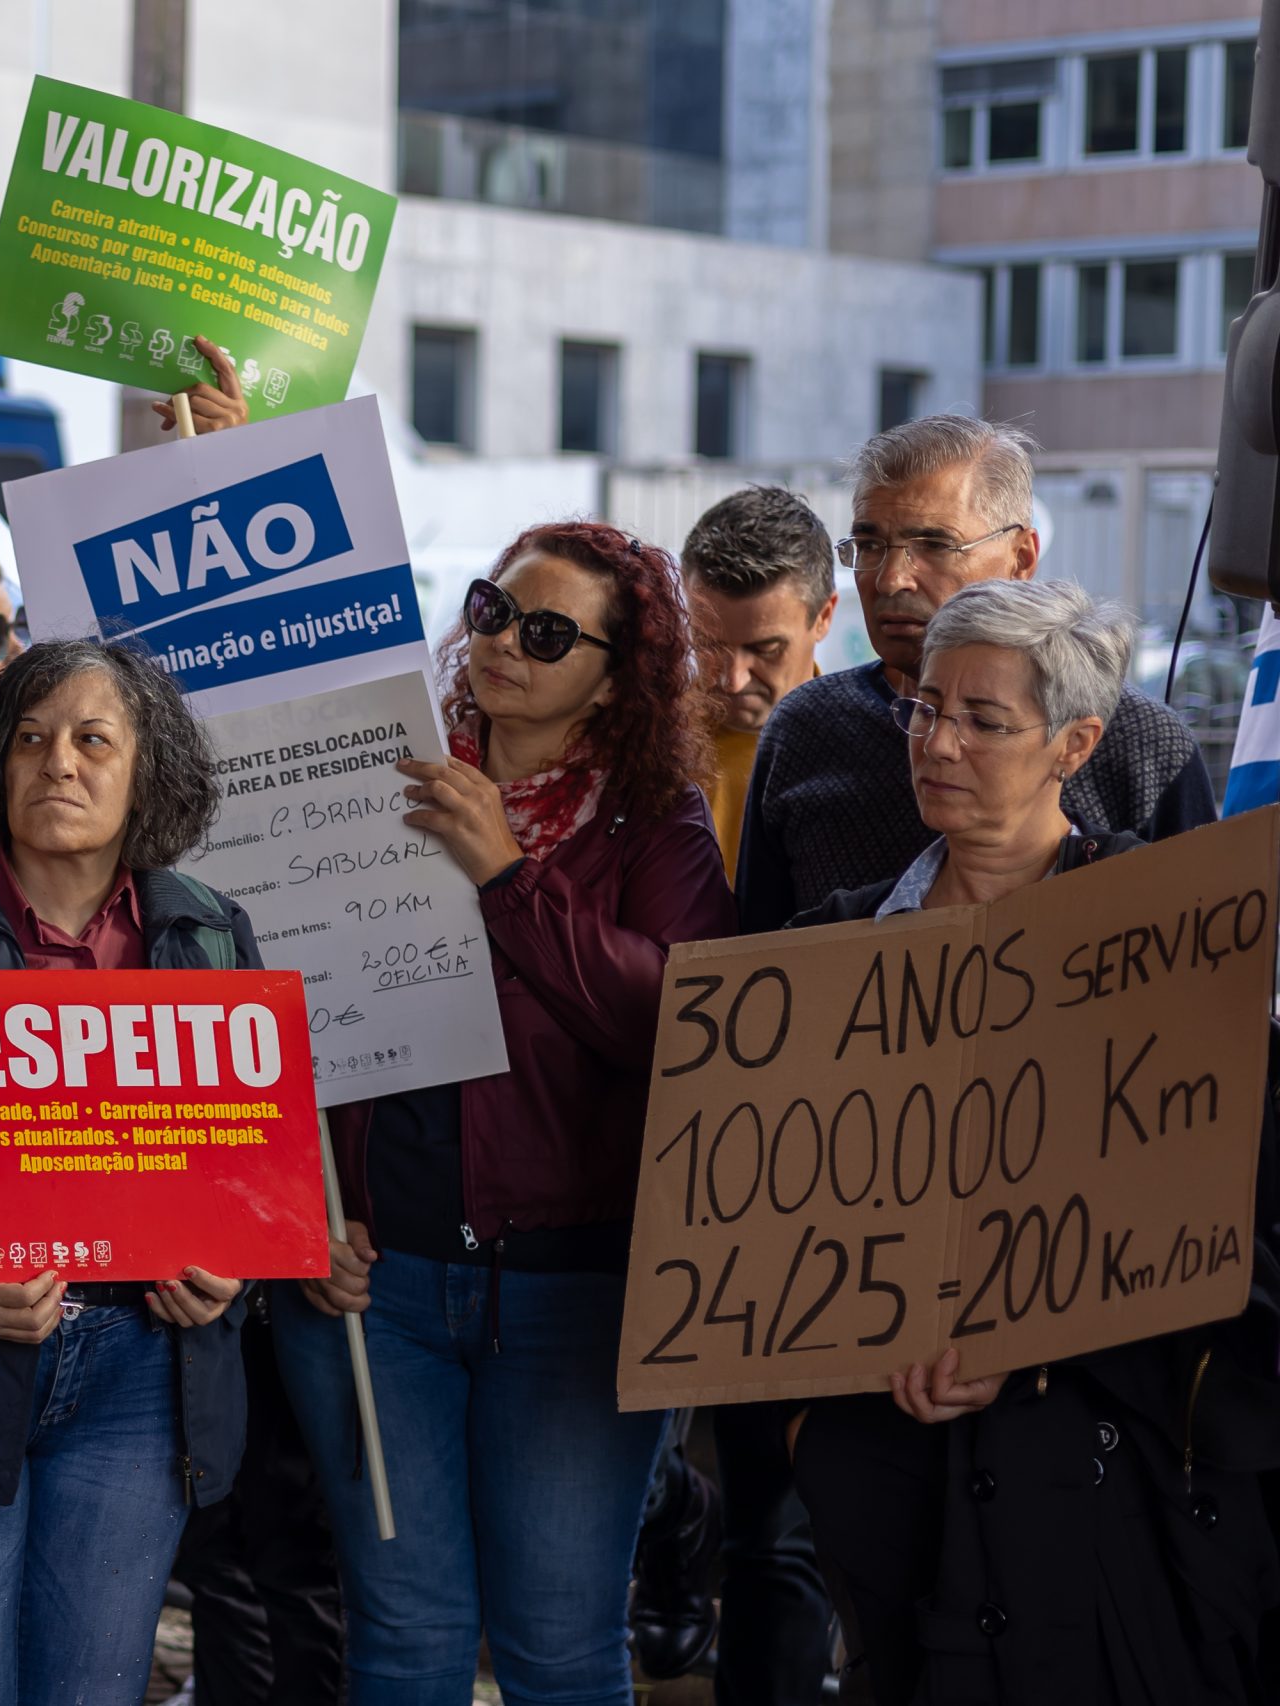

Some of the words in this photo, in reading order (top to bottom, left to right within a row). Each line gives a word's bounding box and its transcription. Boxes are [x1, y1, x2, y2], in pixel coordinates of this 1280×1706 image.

[42, 110, 371, 273] VALORIZAÇÃO
[17, 215, 99, 252] Concursos
[102, 239, 130, 261] por
[131, 248, 214, 283] graduação
[228, 273, 278, 307] Apoios
[279, 293, 311, 320] para
[313, 303, 351, 338] todos
[51, 199, 114, 231] Carreira
[118, 219, 177, 247] atrativa
[193, 238, 256, 273] Horários
[258, 263, 333, 306] adequados
[30, 242, 131, 283] Aposentação
[133, 267, 174, 293] justa
[190, 282, 242, 316] Gestão
[243, 299, 329, 352] democrática
[111, 501, 317, 606] NÃO
[260, 629, 277, 651] e
[279, 594, 402, 649] injustiça!
[279, 722, 408, 763] DESLOCADO/A
[227, 774, 277, 798] ÁREA
[280, 769, 305, 786] DE
[307, 745, 415, 780] RESIDÊNCIA
[270, 806, 293, 838] C.
[288, 832, 442, 885] SABUGAL
[281, 928, 300, 940] em
[302, 920, 332, 935] kms:
[345, 898, 387, 922] 90
[395, 893, 433, 913] KM
[378, 959, 469, 987] OFICINA
[661, 965, 792, 1079] 30
[835, 929, 1036, 1060] ANOS
[1056, 888, 1267, 1008] SERVIÇO
[39, 1101, 79, 1121] não!
[99, 1101, 173, 1121] Carreira
[175, 1102, 283, 1122] recomposta.
[1099, 1032, 1219, 1159] Km
[13, 1128, 119, 1147] atualizados.
[133, 1126, 208, 1146] Horários
[210, 1127, 268, 1147] legais.
[20, 1153, 134, 1175] Aposentação
[136, 1152, 188, 1173] justa!
[640, 1224, 909, 1365] 24/25
